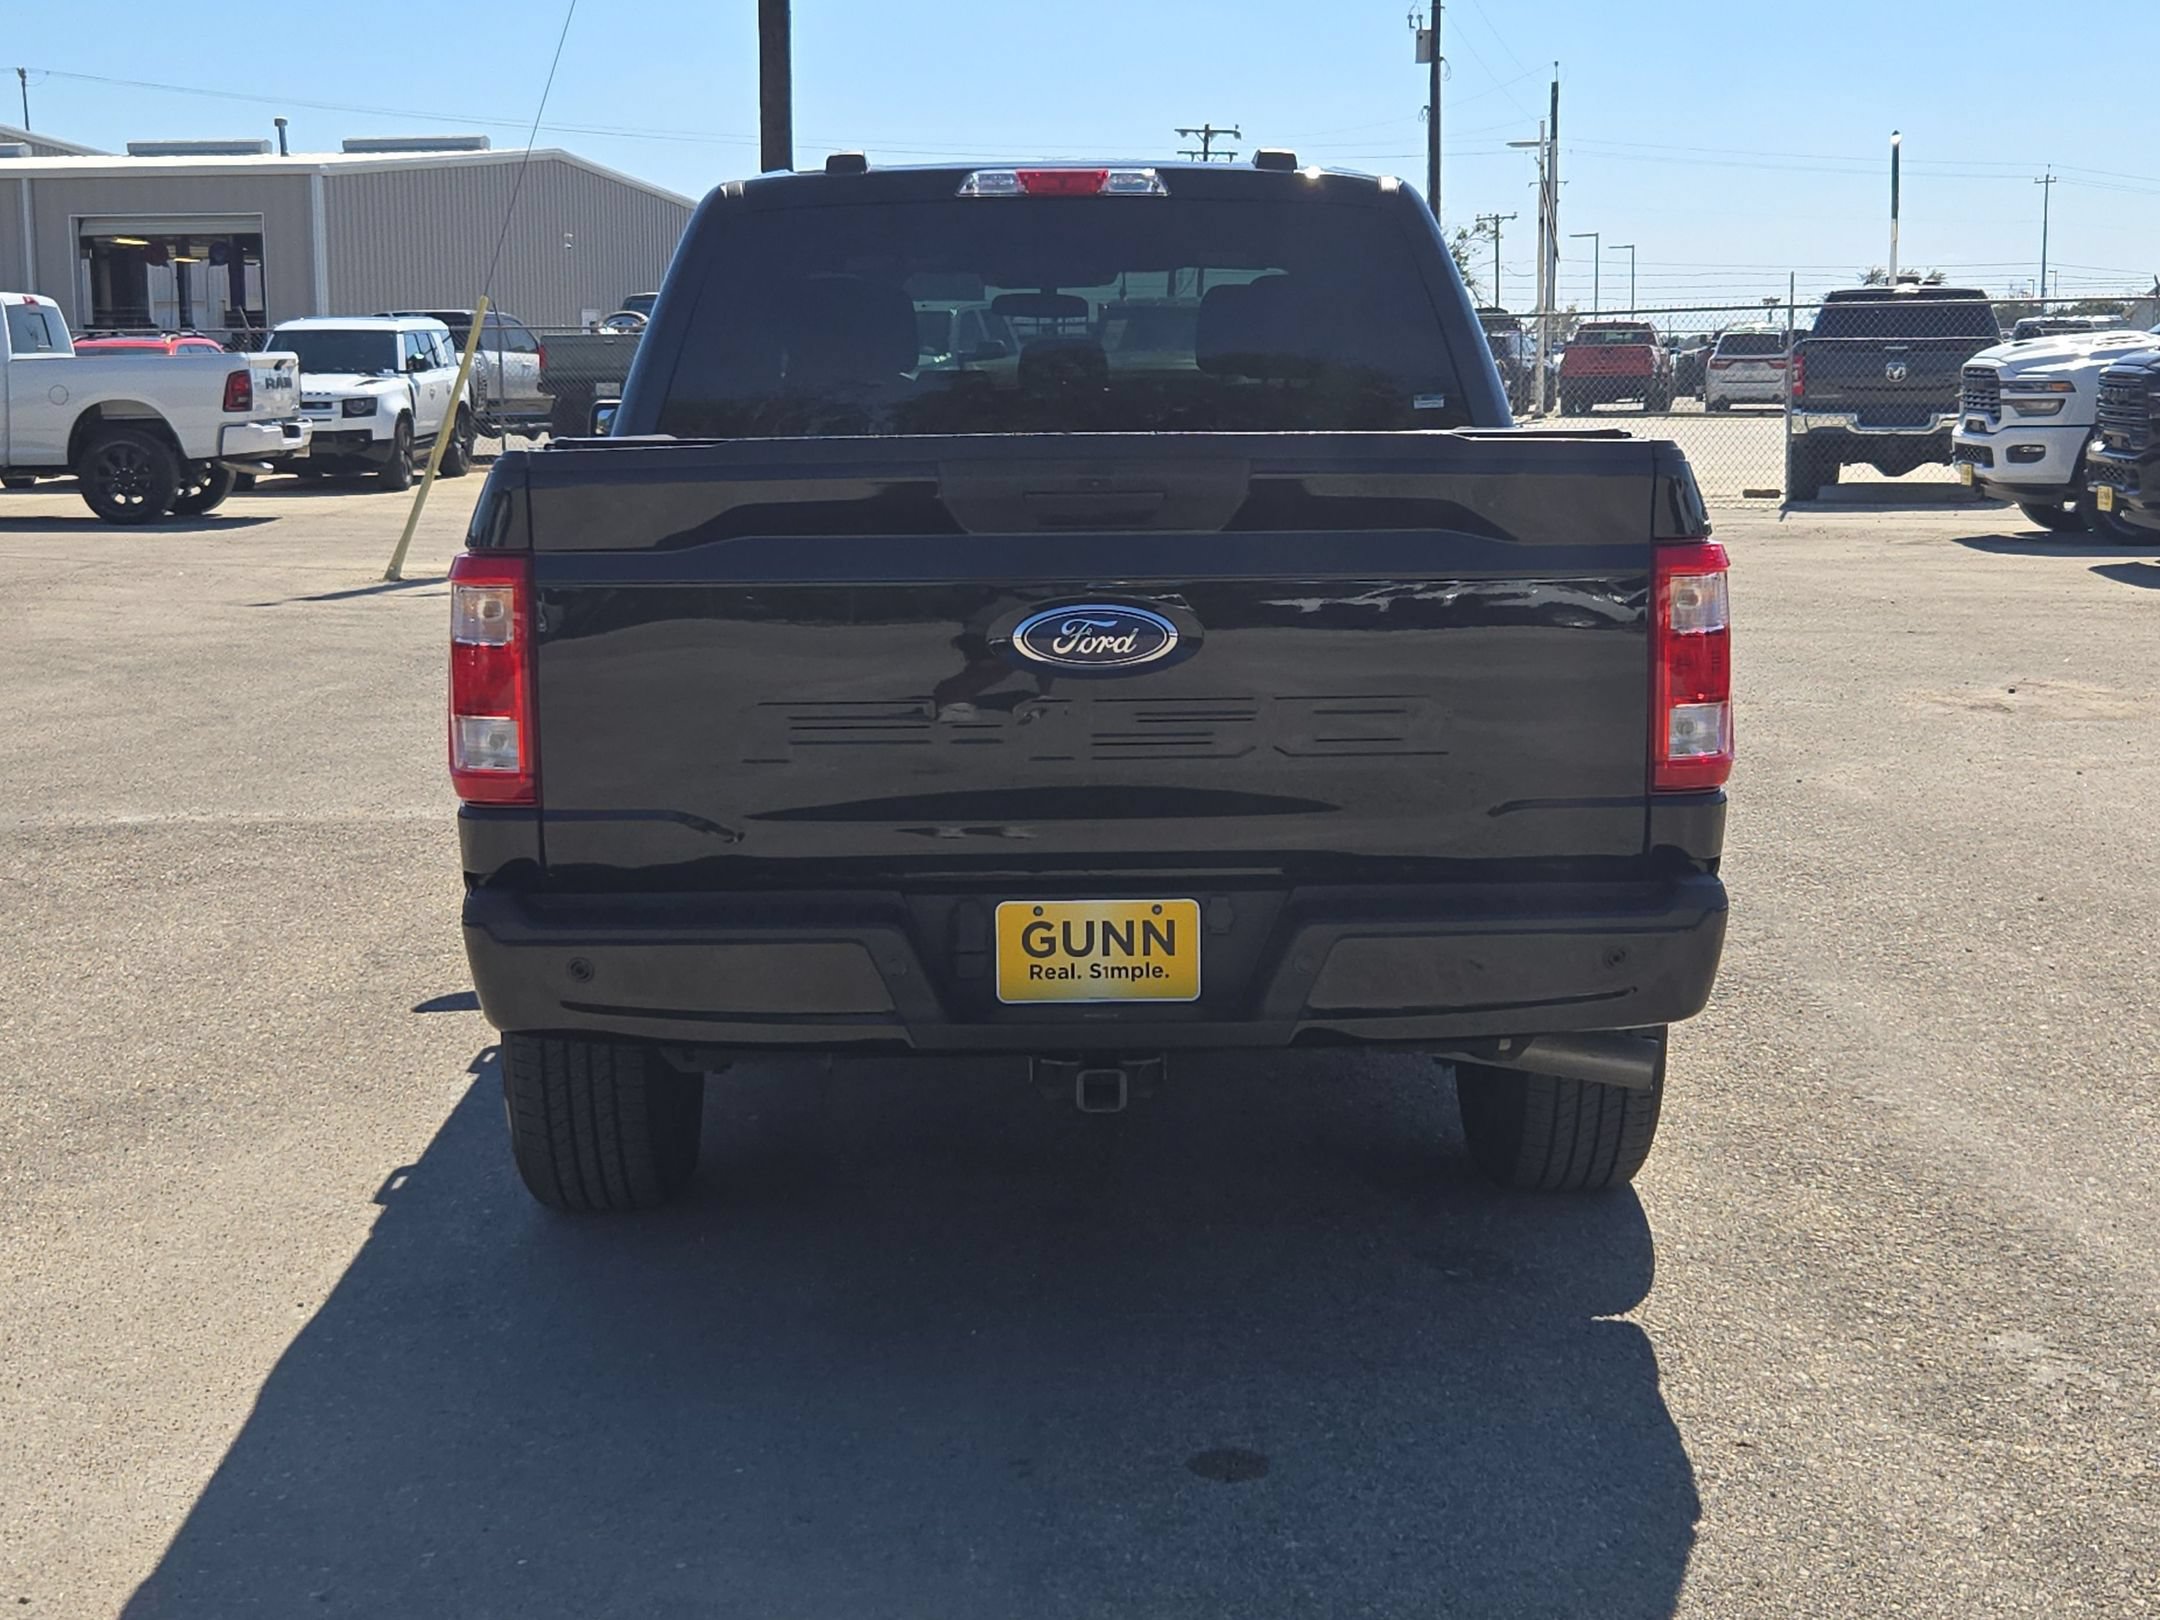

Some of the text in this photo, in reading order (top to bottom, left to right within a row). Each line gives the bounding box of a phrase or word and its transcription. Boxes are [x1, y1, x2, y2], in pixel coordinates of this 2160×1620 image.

[1052, 618, 1140, 655] Ford
[1021, 919, 1175, 959] GUNN
[1029, 962, 1082, 981] Real.
